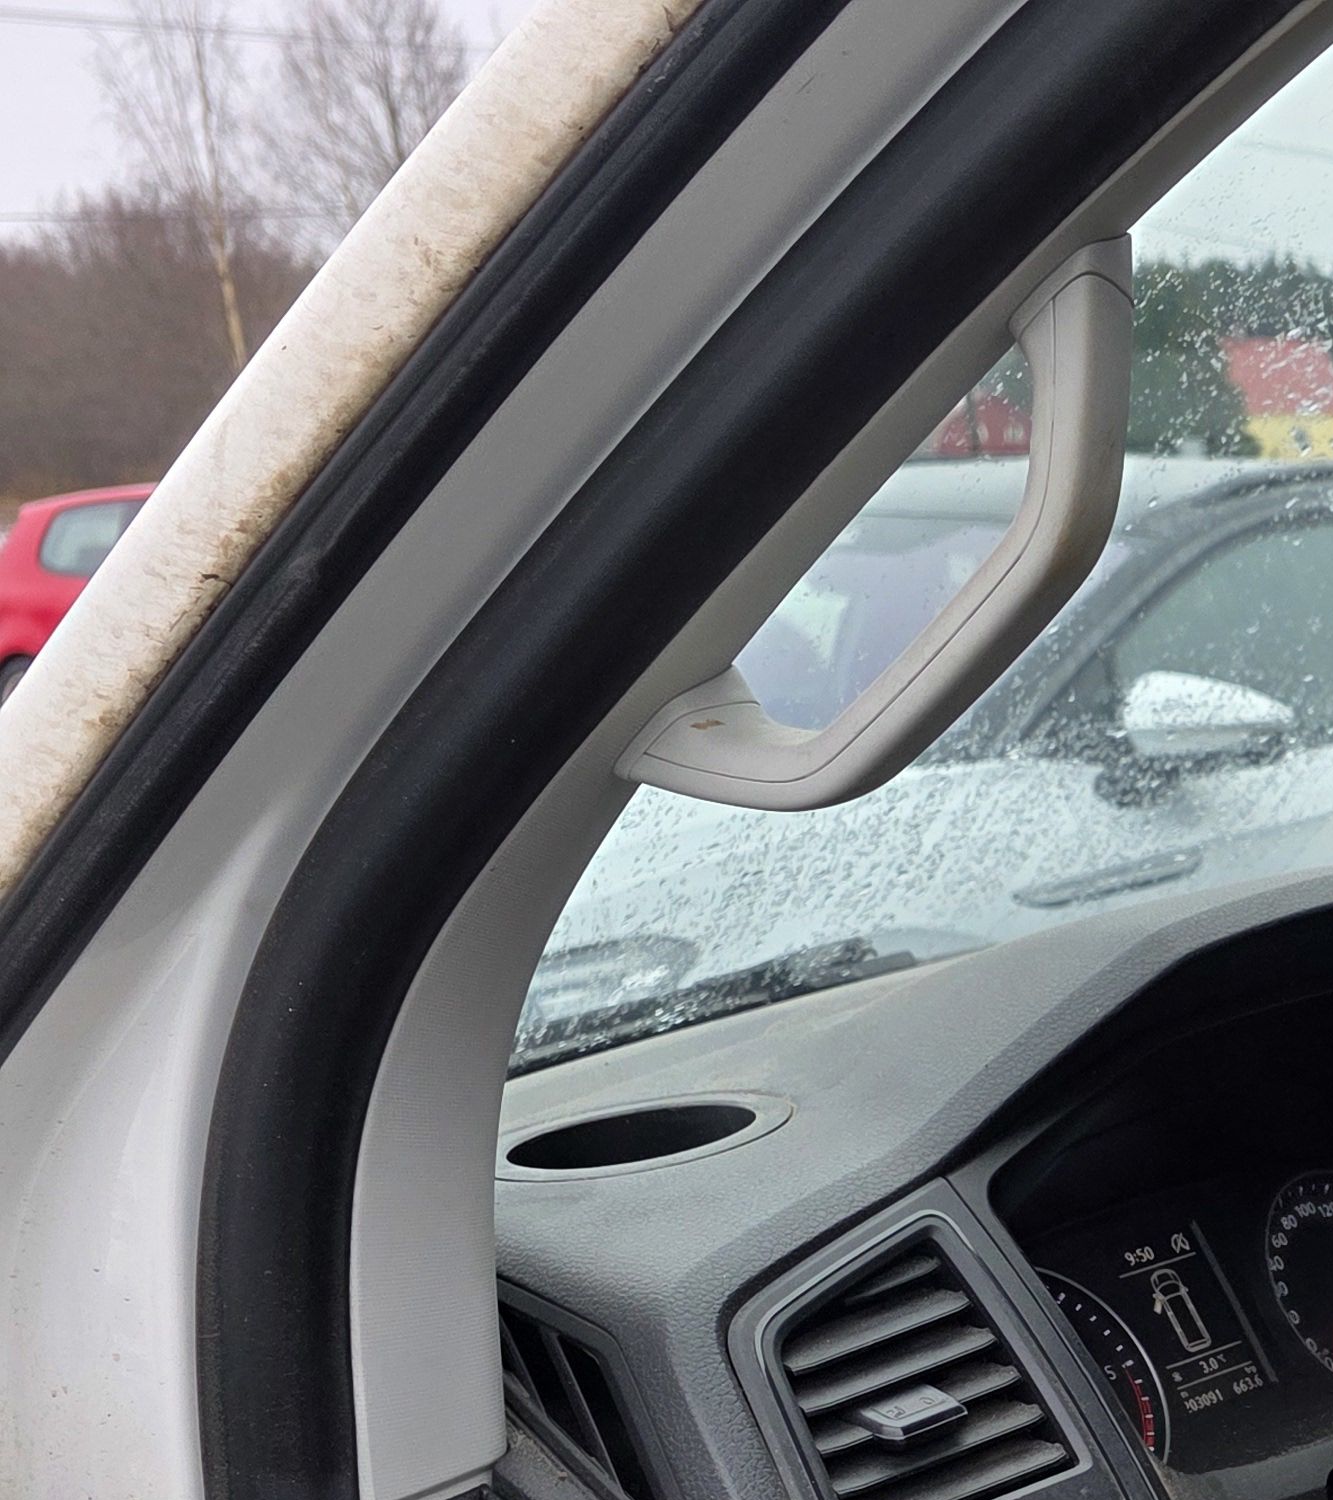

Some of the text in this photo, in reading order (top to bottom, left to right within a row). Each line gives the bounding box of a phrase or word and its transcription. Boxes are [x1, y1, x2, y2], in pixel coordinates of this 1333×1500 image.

[1295, 1201, 1316, 1219] 100
[1280, 1214, 1298, 1230] 80
[1271, 1232, 1289, 1248] 60
[1124, 1245, 1155, 1267] 9:50
